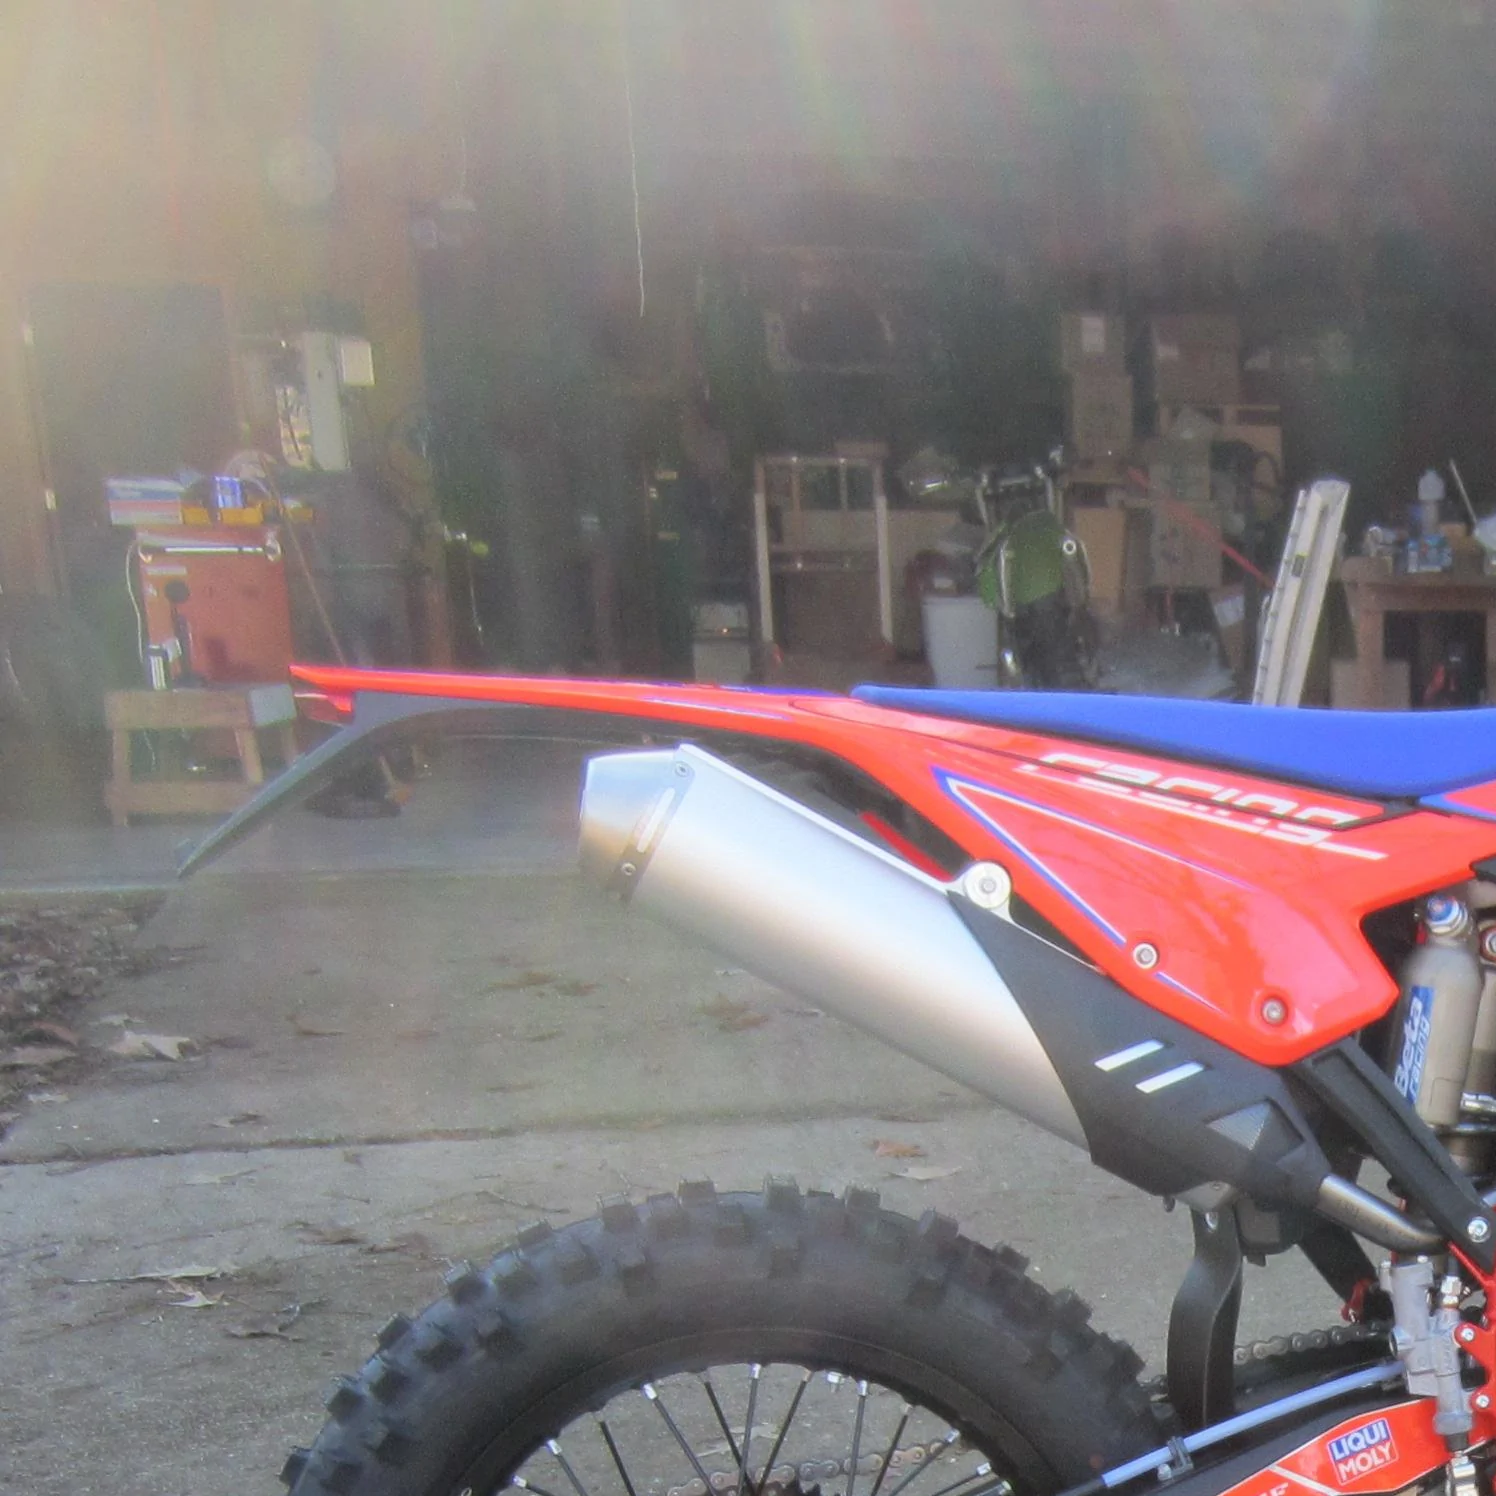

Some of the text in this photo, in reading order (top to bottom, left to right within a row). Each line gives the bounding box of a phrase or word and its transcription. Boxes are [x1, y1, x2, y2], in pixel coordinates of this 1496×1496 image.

[1395, 996, 1423, 1097] Beta
[1409, 1015, 1430, 1101] racing
[1331, 1421, 1388, 1461] LIQUI
[1338, 1441, 1391, 1481] MOLY
